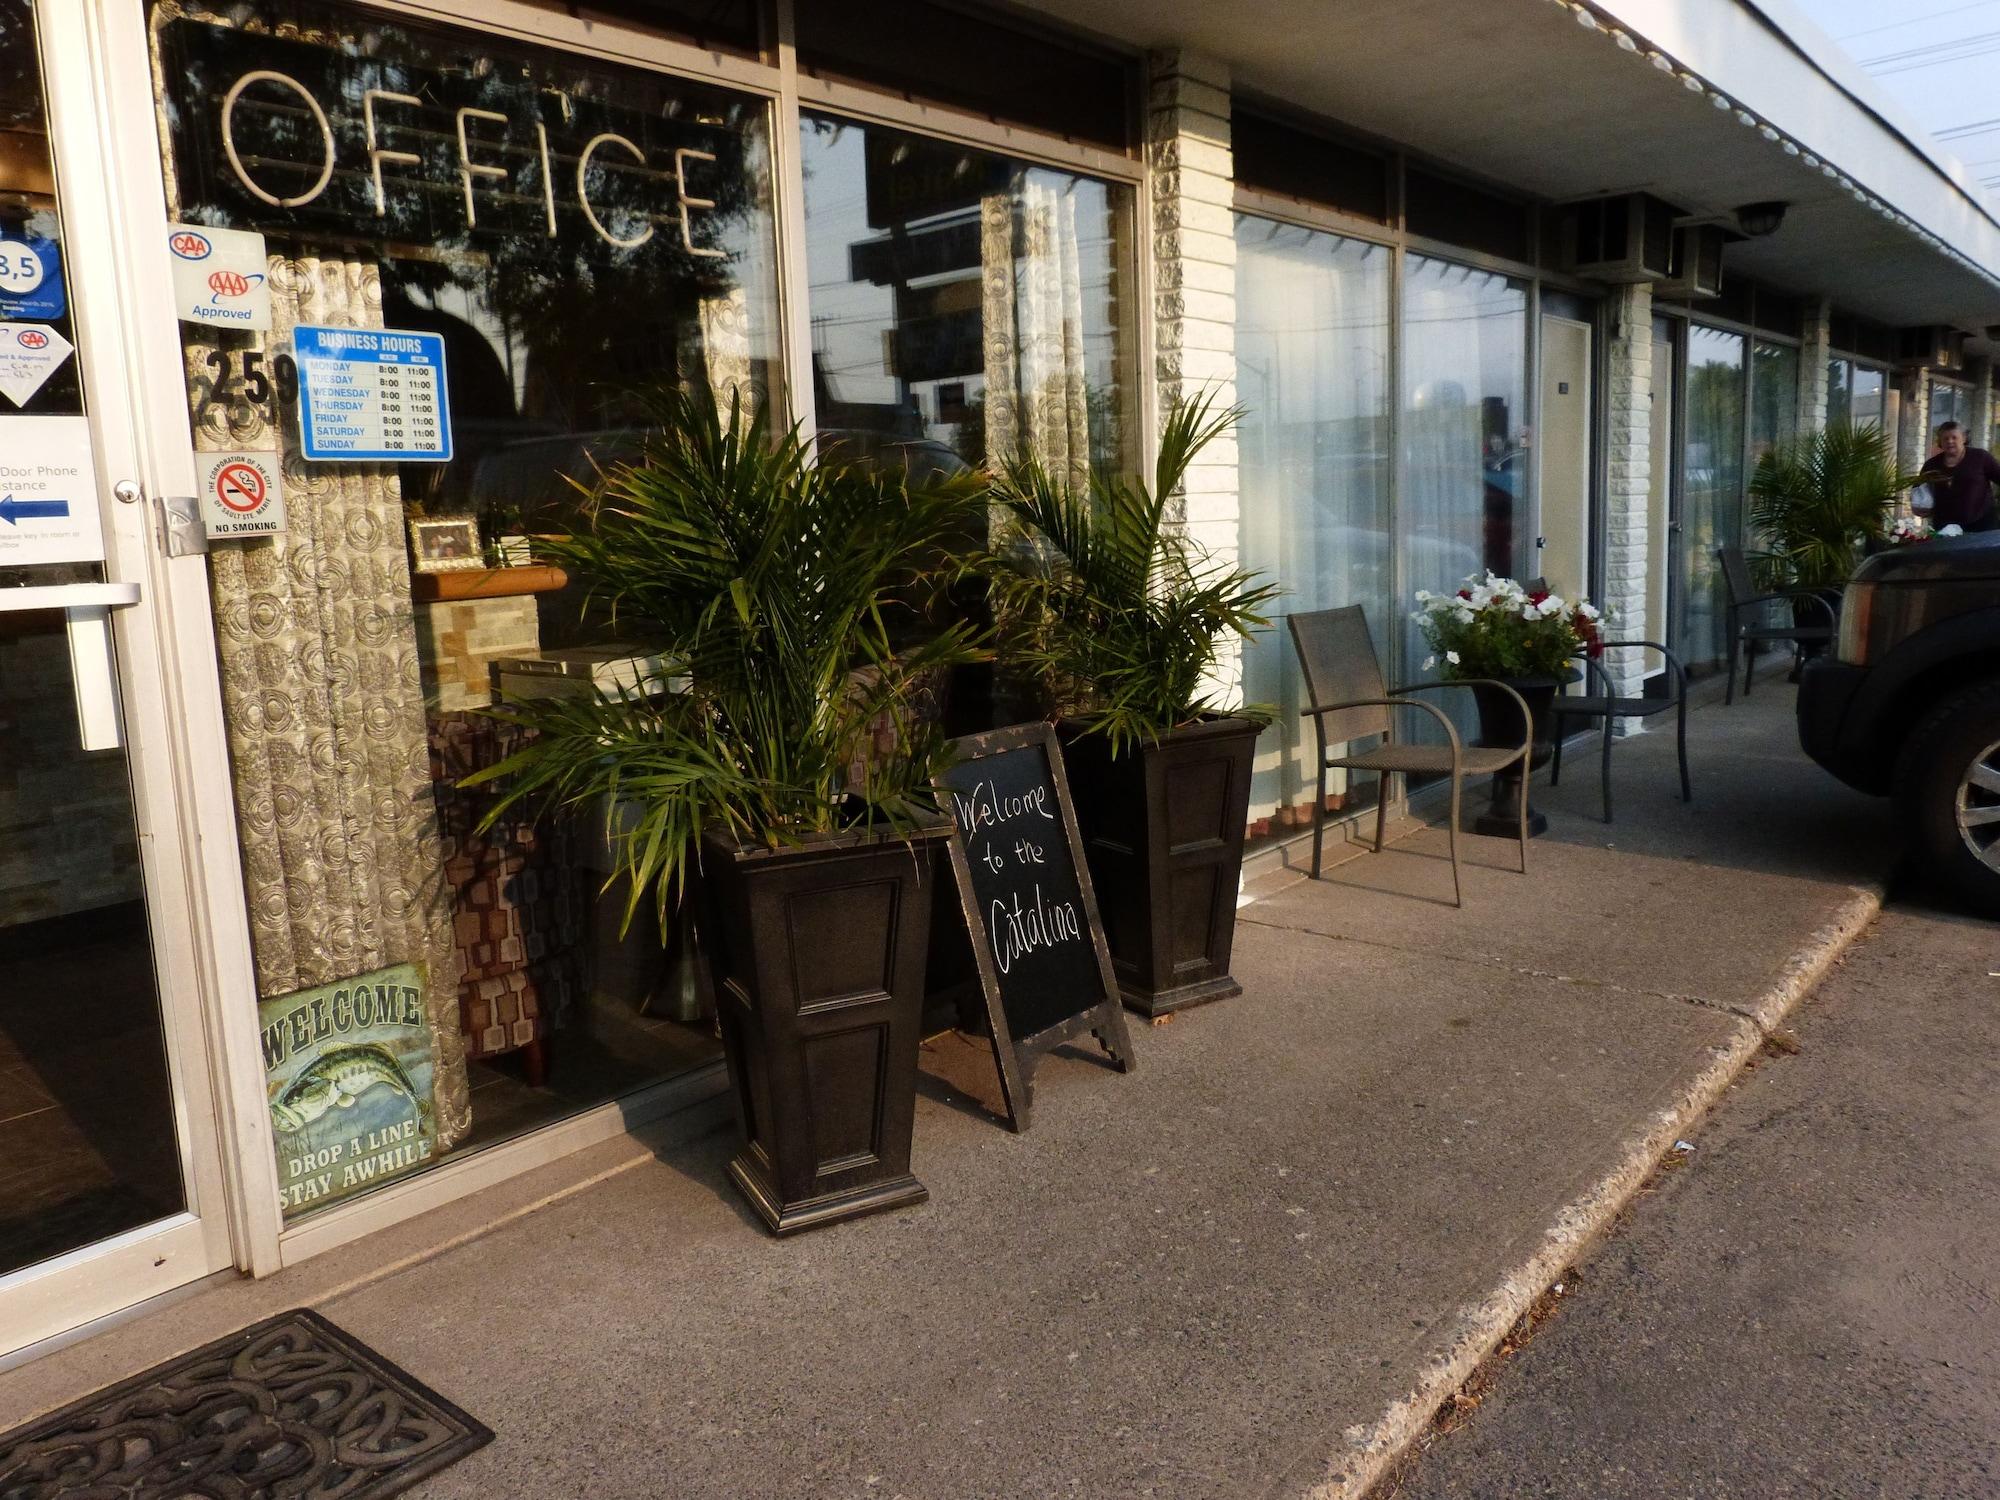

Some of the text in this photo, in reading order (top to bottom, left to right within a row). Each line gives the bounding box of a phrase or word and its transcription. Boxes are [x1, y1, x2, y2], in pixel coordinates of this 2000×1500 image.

[221, 70, 727, 257] OFFICE
[173, 235, 206, 256] CAA
[209, 272, 247, 296] AAA
[192, 305, 252, 320] Approved
[21, 332, 46, 347] CAA
[317, 331, 422, 354] BUSINESS HOURS
[206, 350, 299, 404] 259
[310, 360, 429, 376] MONDAY 8:00 11:00
[313, 374, 431, 389] TUESDAY 8:00 11:00
[313, 387, 431, 401] WEDNESDAY 8:00 11:00
[315, 400, 433, 413] THURSDAY 8:00 11:00
[315, 413, 434, 426] FRIDAY 8:00 11:00
[317, 426, 435, 438] SATURDAY 8:00 11:00
[317, 439, 436, 450] SUNDAY 8:00 11:00
[0, 466, 79, 477] Door Phone
[209, 456, 246, 479] CORPORATION
[255, 463, 267, 474] THE
[0, 482, 47, 491] stance
[214, 500, 222, 508] OF
[222, 507, 241, 520] SAULT
[256, 497, 271, 515] MARIE
[215, 521, 277, 533] NO SMOKING
[953, 779, 1054, 834] Welcome
[983, 838, 1044, 874] to the
[991, 883, 1081, 974] Catalina
[260, 984, 423, 1072] WELCOME
[288, 1119, 415, 1178] DROP A LINE
[279, 1139, 432, 1211] STAY AWHILE
